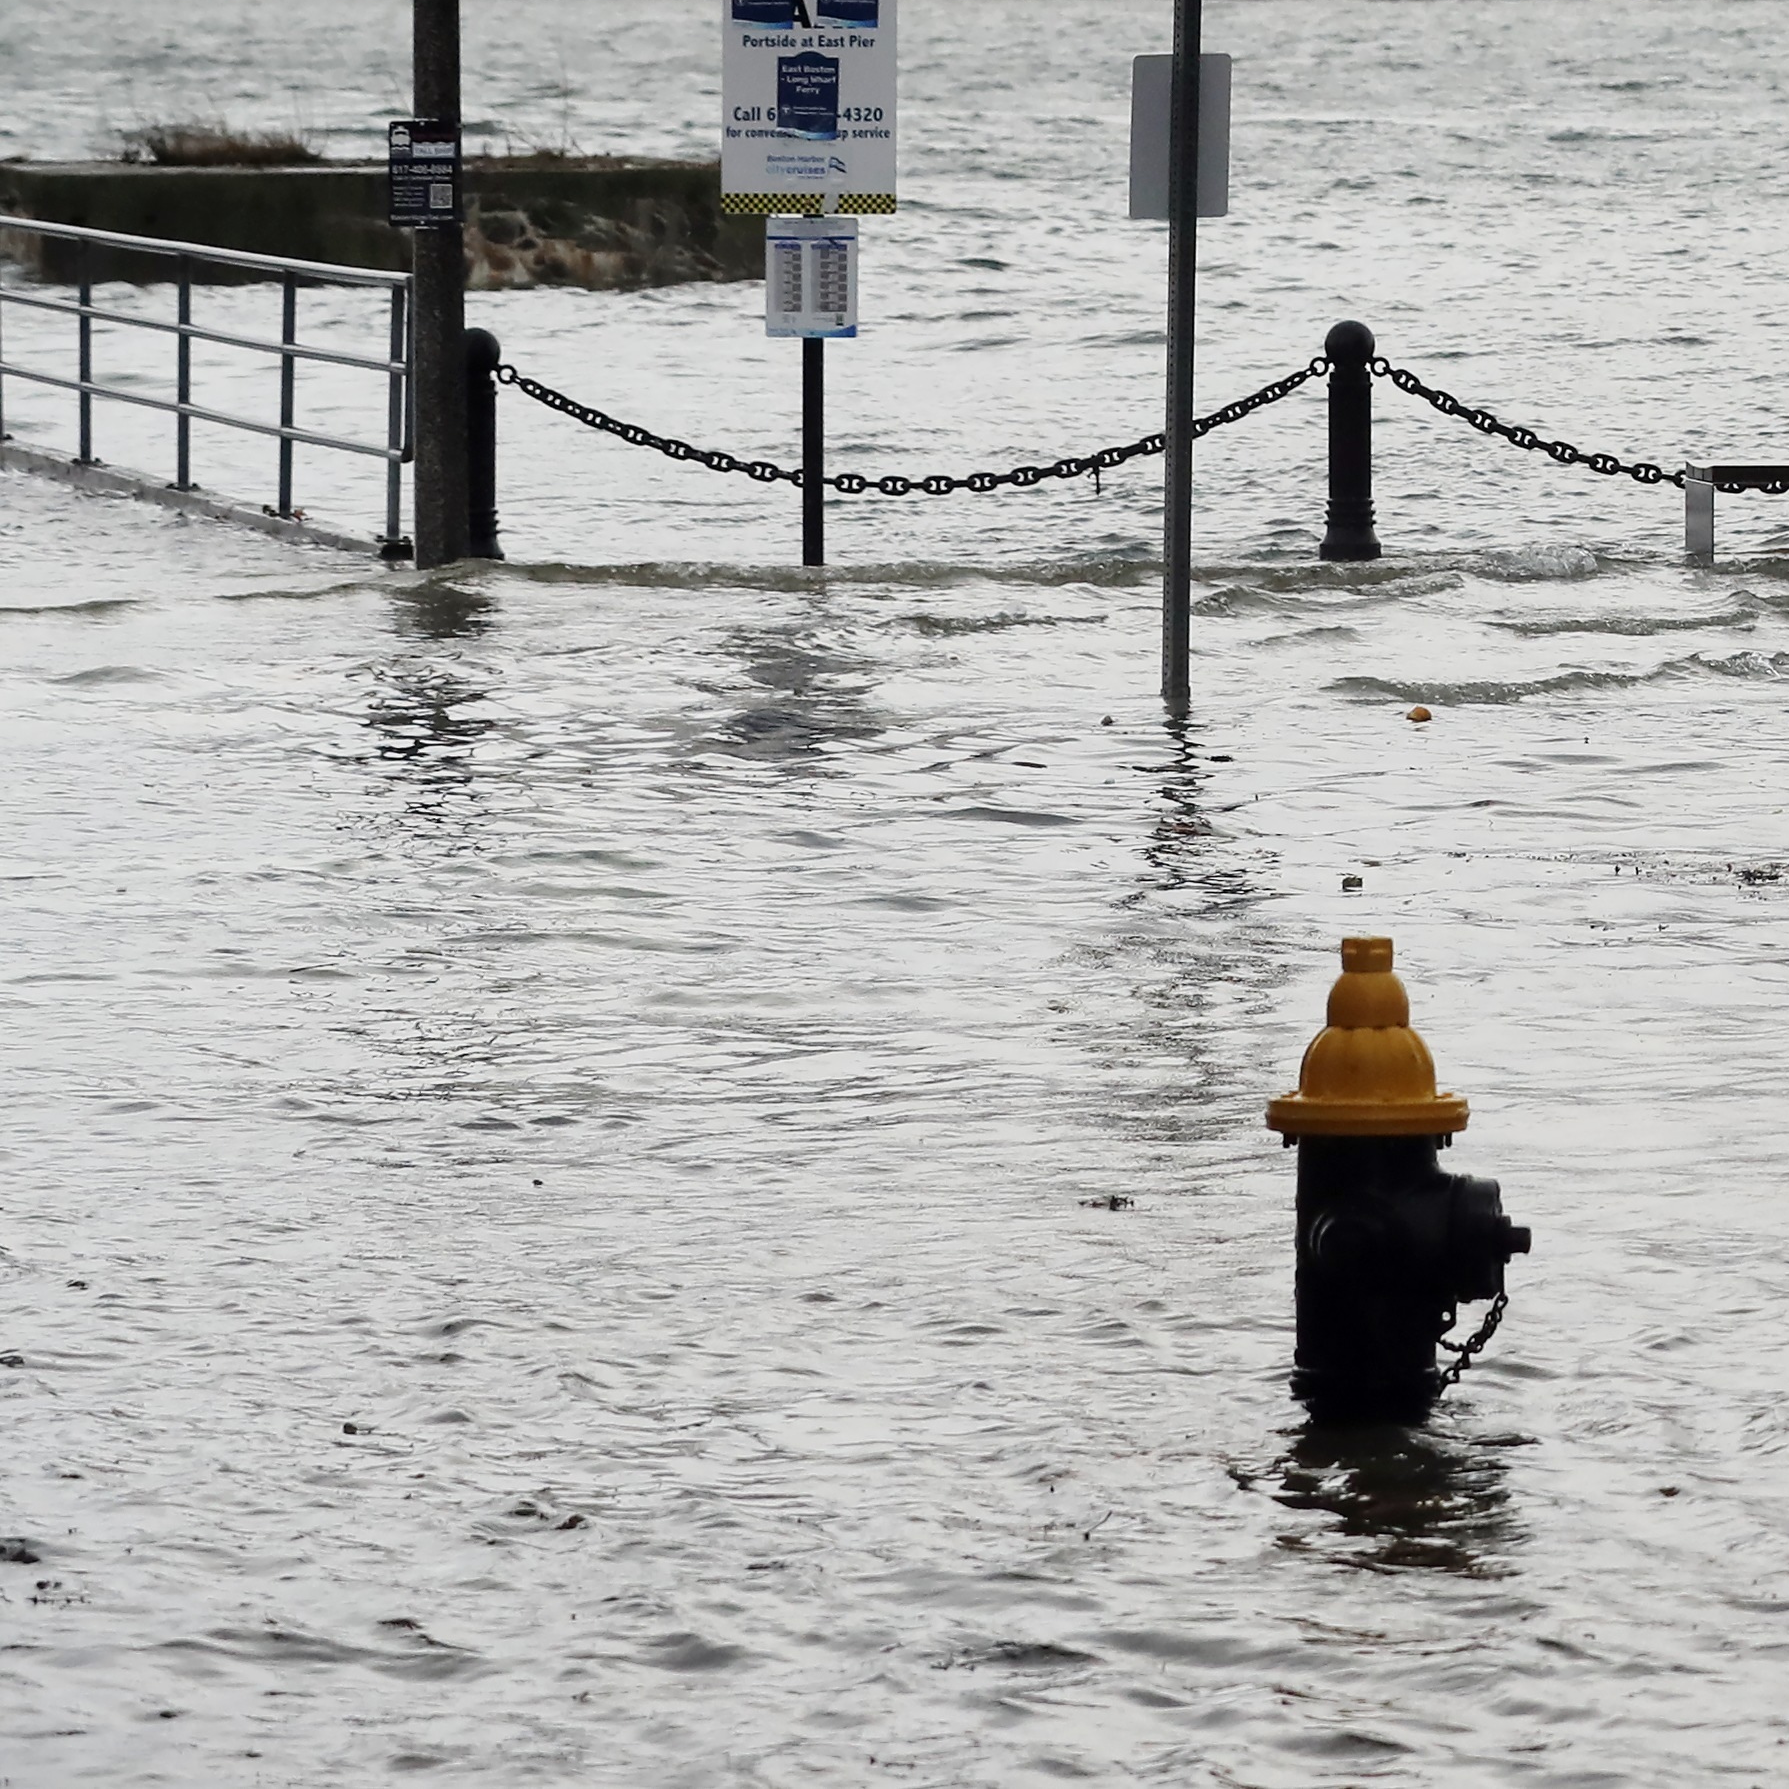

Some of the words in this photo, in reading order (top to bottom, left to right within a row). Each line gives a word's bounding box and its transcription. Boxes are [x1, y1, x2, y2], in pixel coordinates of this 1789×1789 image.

[743, 34, 798, 48] Portside
[801, 34, 814, 48] at
[818, 34, 845, 48] East
[849, 34, 876, 48] Pier
[782, 64, 802, 73] East
[803, 65, 835, 73] Boston
[787, 76, 809, 85] Long
[796, 86, 820, 94] Ferry
[733, 106, 761, 122] Call
[726, 126, 742, 139] for
[852, 125, 891, 139] service
